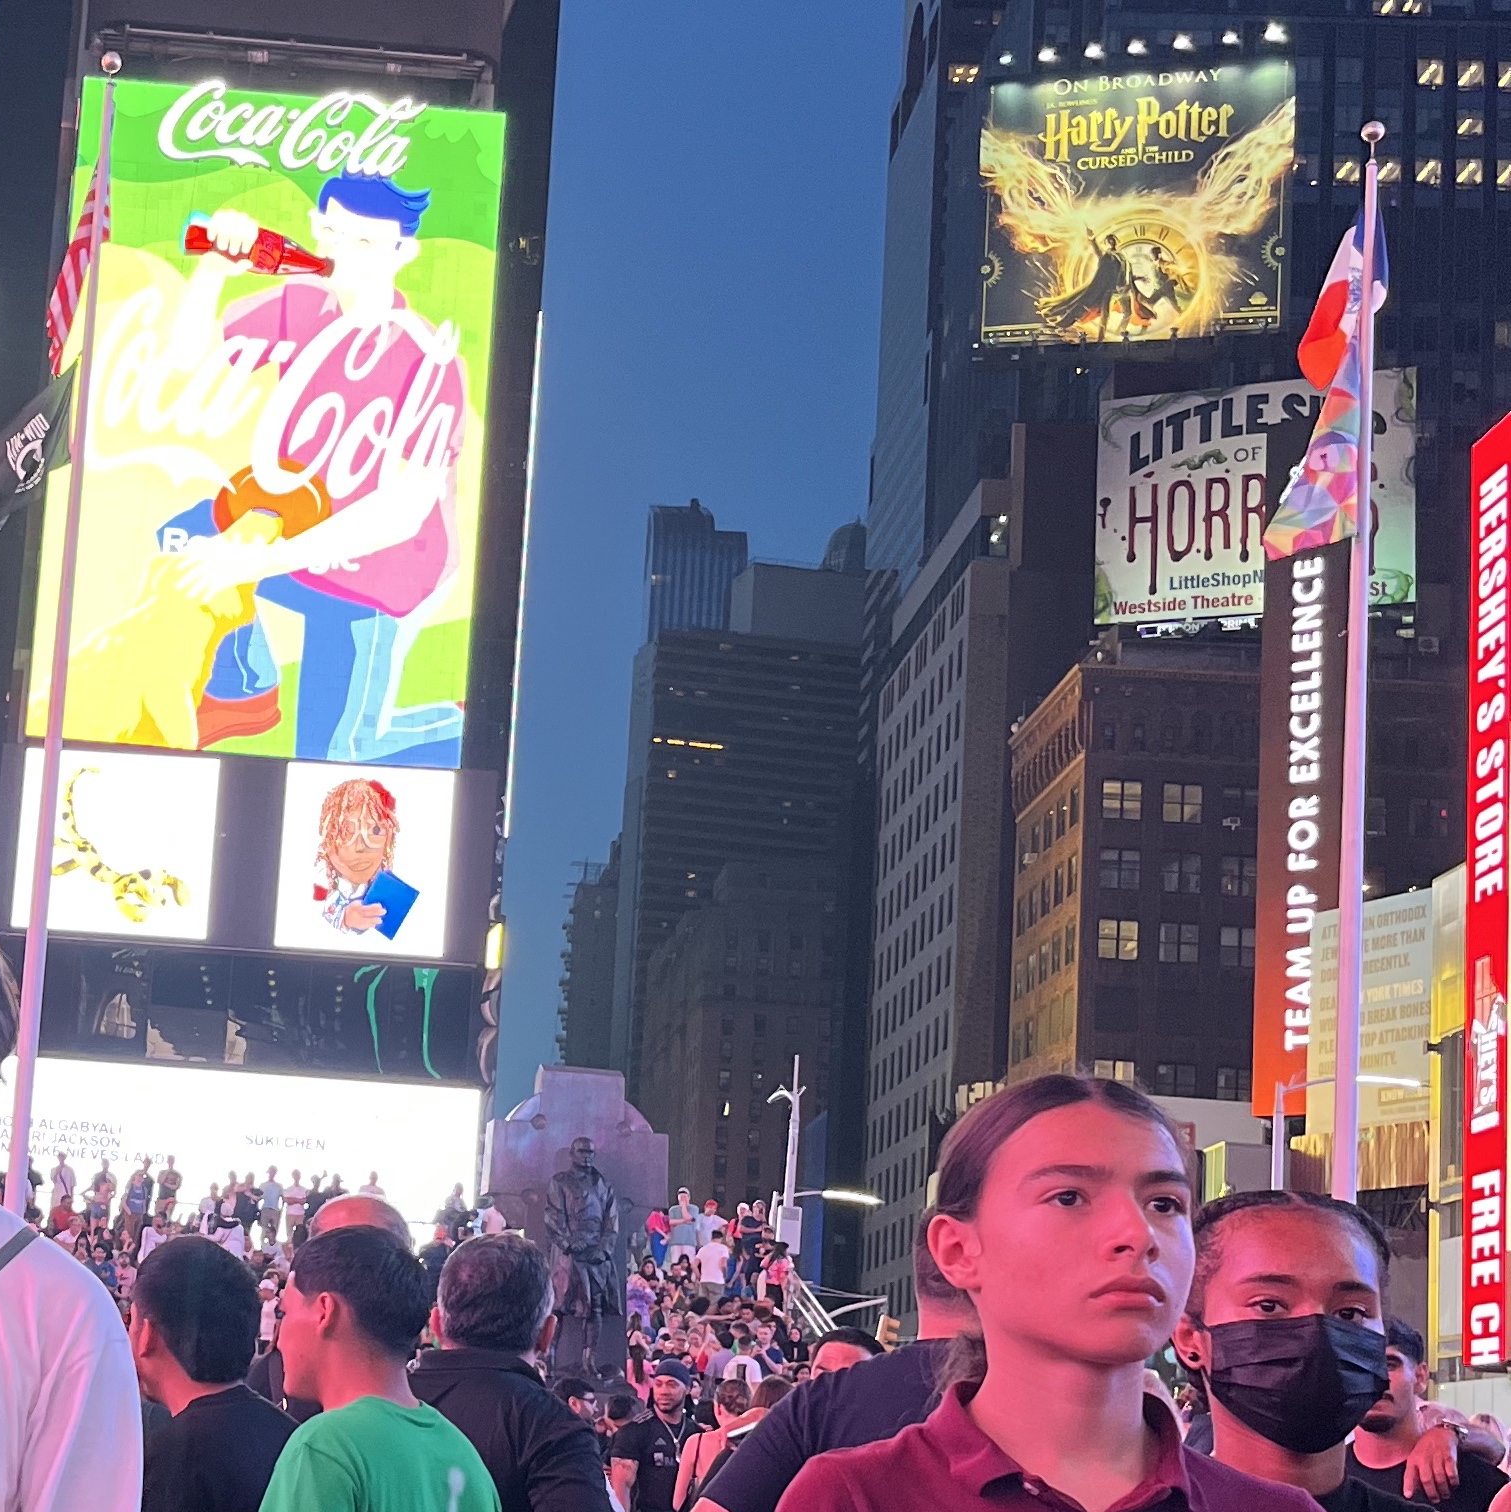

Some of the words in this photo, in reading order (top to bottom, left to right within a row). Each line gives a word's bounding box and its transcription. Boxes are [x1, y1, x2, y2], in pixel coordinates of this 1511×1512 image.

[1053, 78, 1088, 95] ON
[1098, 69, 1222, 92] BROADWAY
[157, 79, 428, 177] Coca-Cola
[1038, 107, 1134, 162] Harry
[1136, 96, 1234, 159] Potter
[1077, 154, 1138, 171] CURSED
[1143, 150, 1195, 165] CHILD
[1129, 393, 1270, 475] LITTLE
[1234, 446, 1263, 463] OF
[1113, 597, 1187, 616] Westside
[1190, 592, 1254, 610] Theatre
[1476, 463, 1508, 734] HERSHEY'S
[1289, 556, 1326, 784] EXCELLENCE
[1287, 794, 1320, 873] FOR
[1474, 738, 1506, 904] STORE
[1285, 884, 1319, 934] UP
[1400, 927, 1426, 944] THAN
[1284, 946, 1312, 1052] TEAM
[1470, 1170, 1502, 1288] FREE
